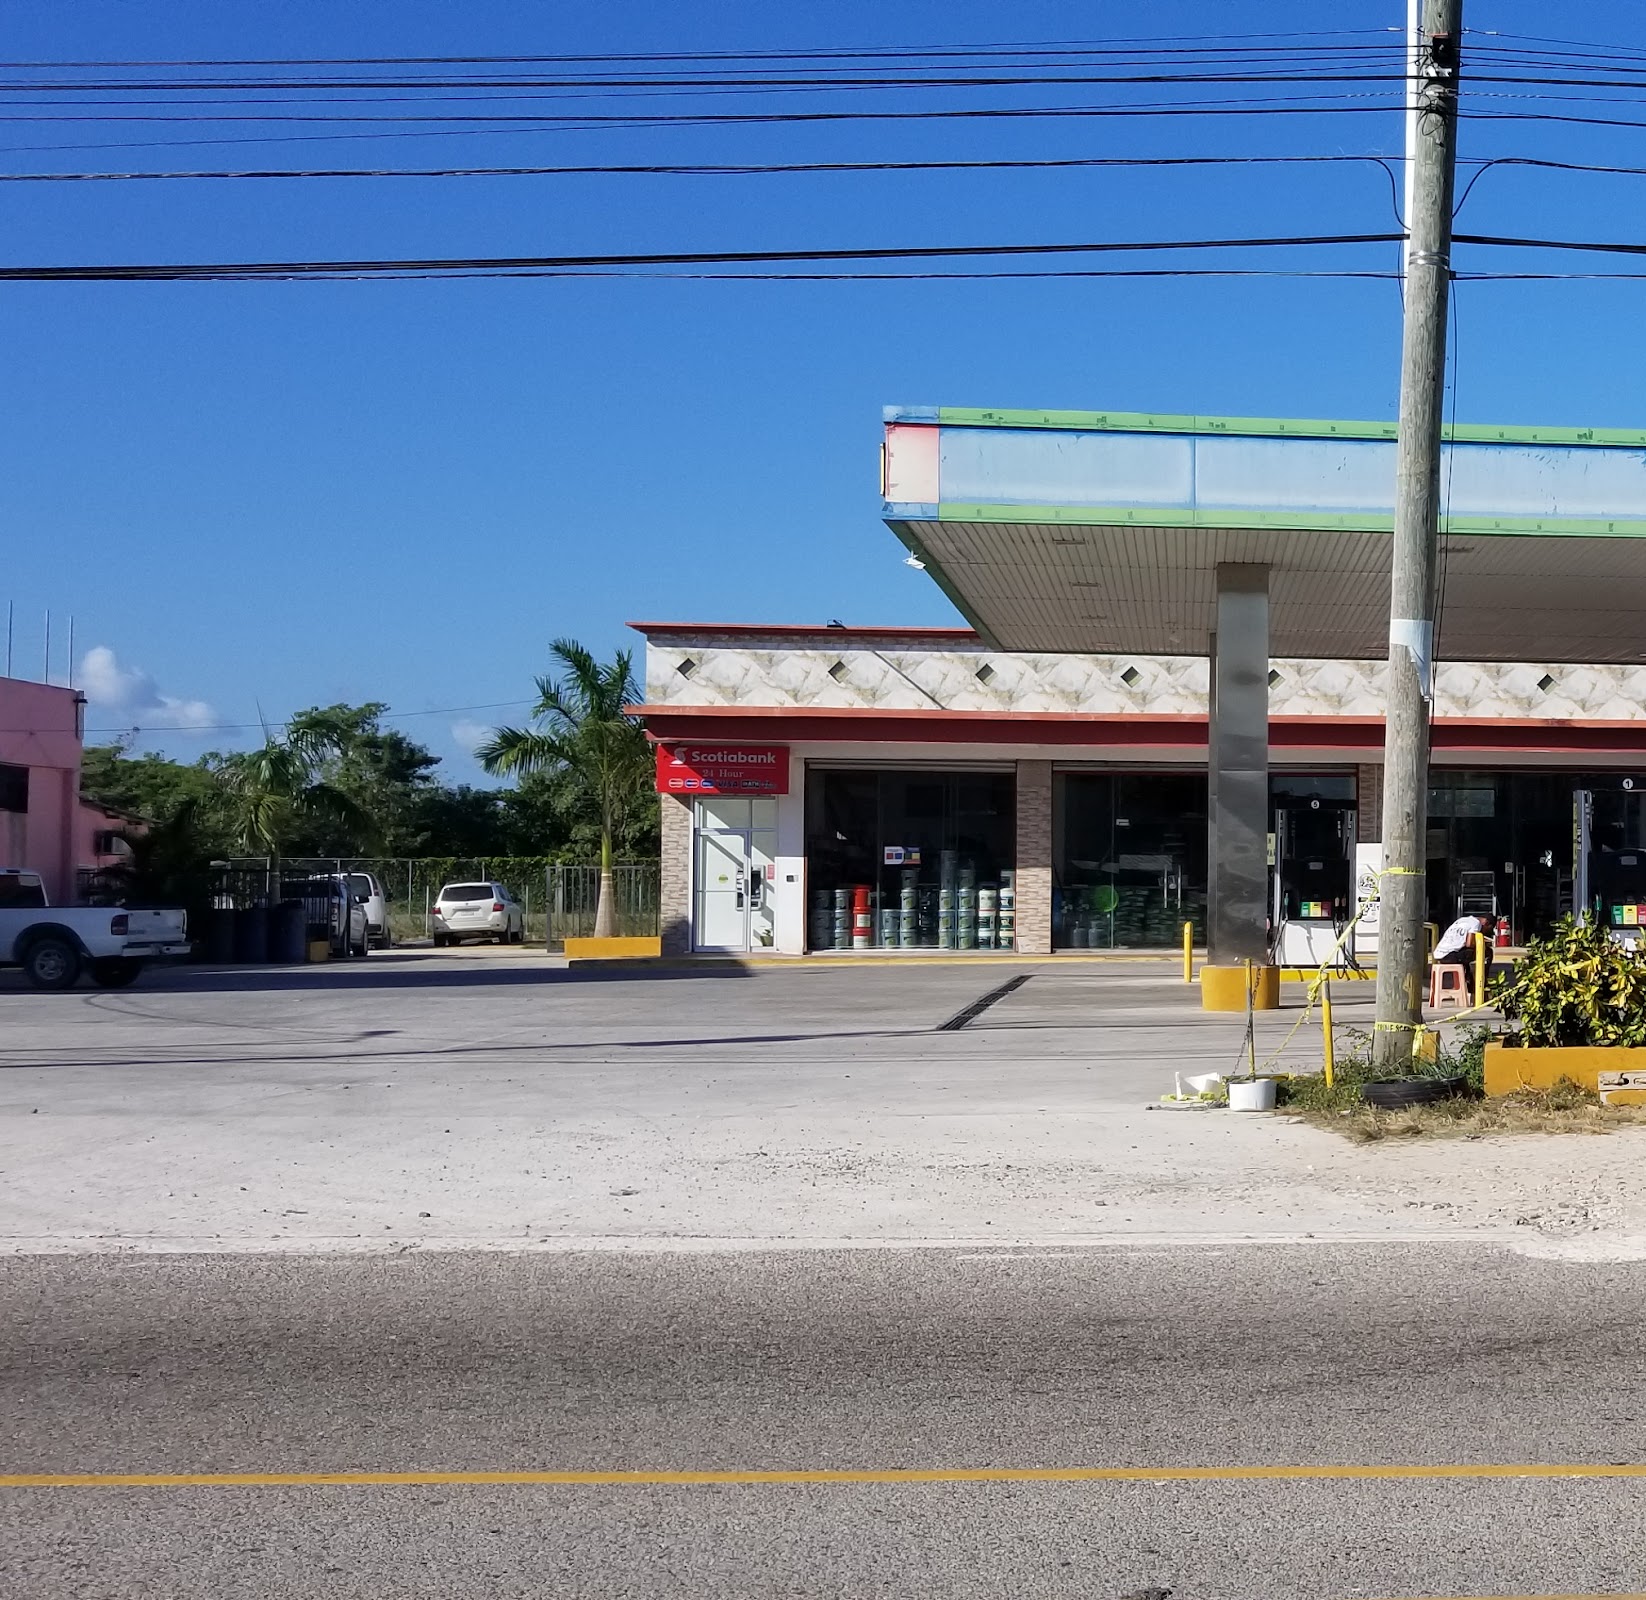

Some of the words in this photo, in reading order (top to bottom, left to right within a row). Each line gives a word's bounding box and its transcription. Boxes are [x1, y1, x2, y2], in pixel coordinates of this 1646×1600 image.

[691, 750, 776, 764] Scotiabank
[702, 769, 714, 778] 24
[719, 769, 744, 778] Hour
